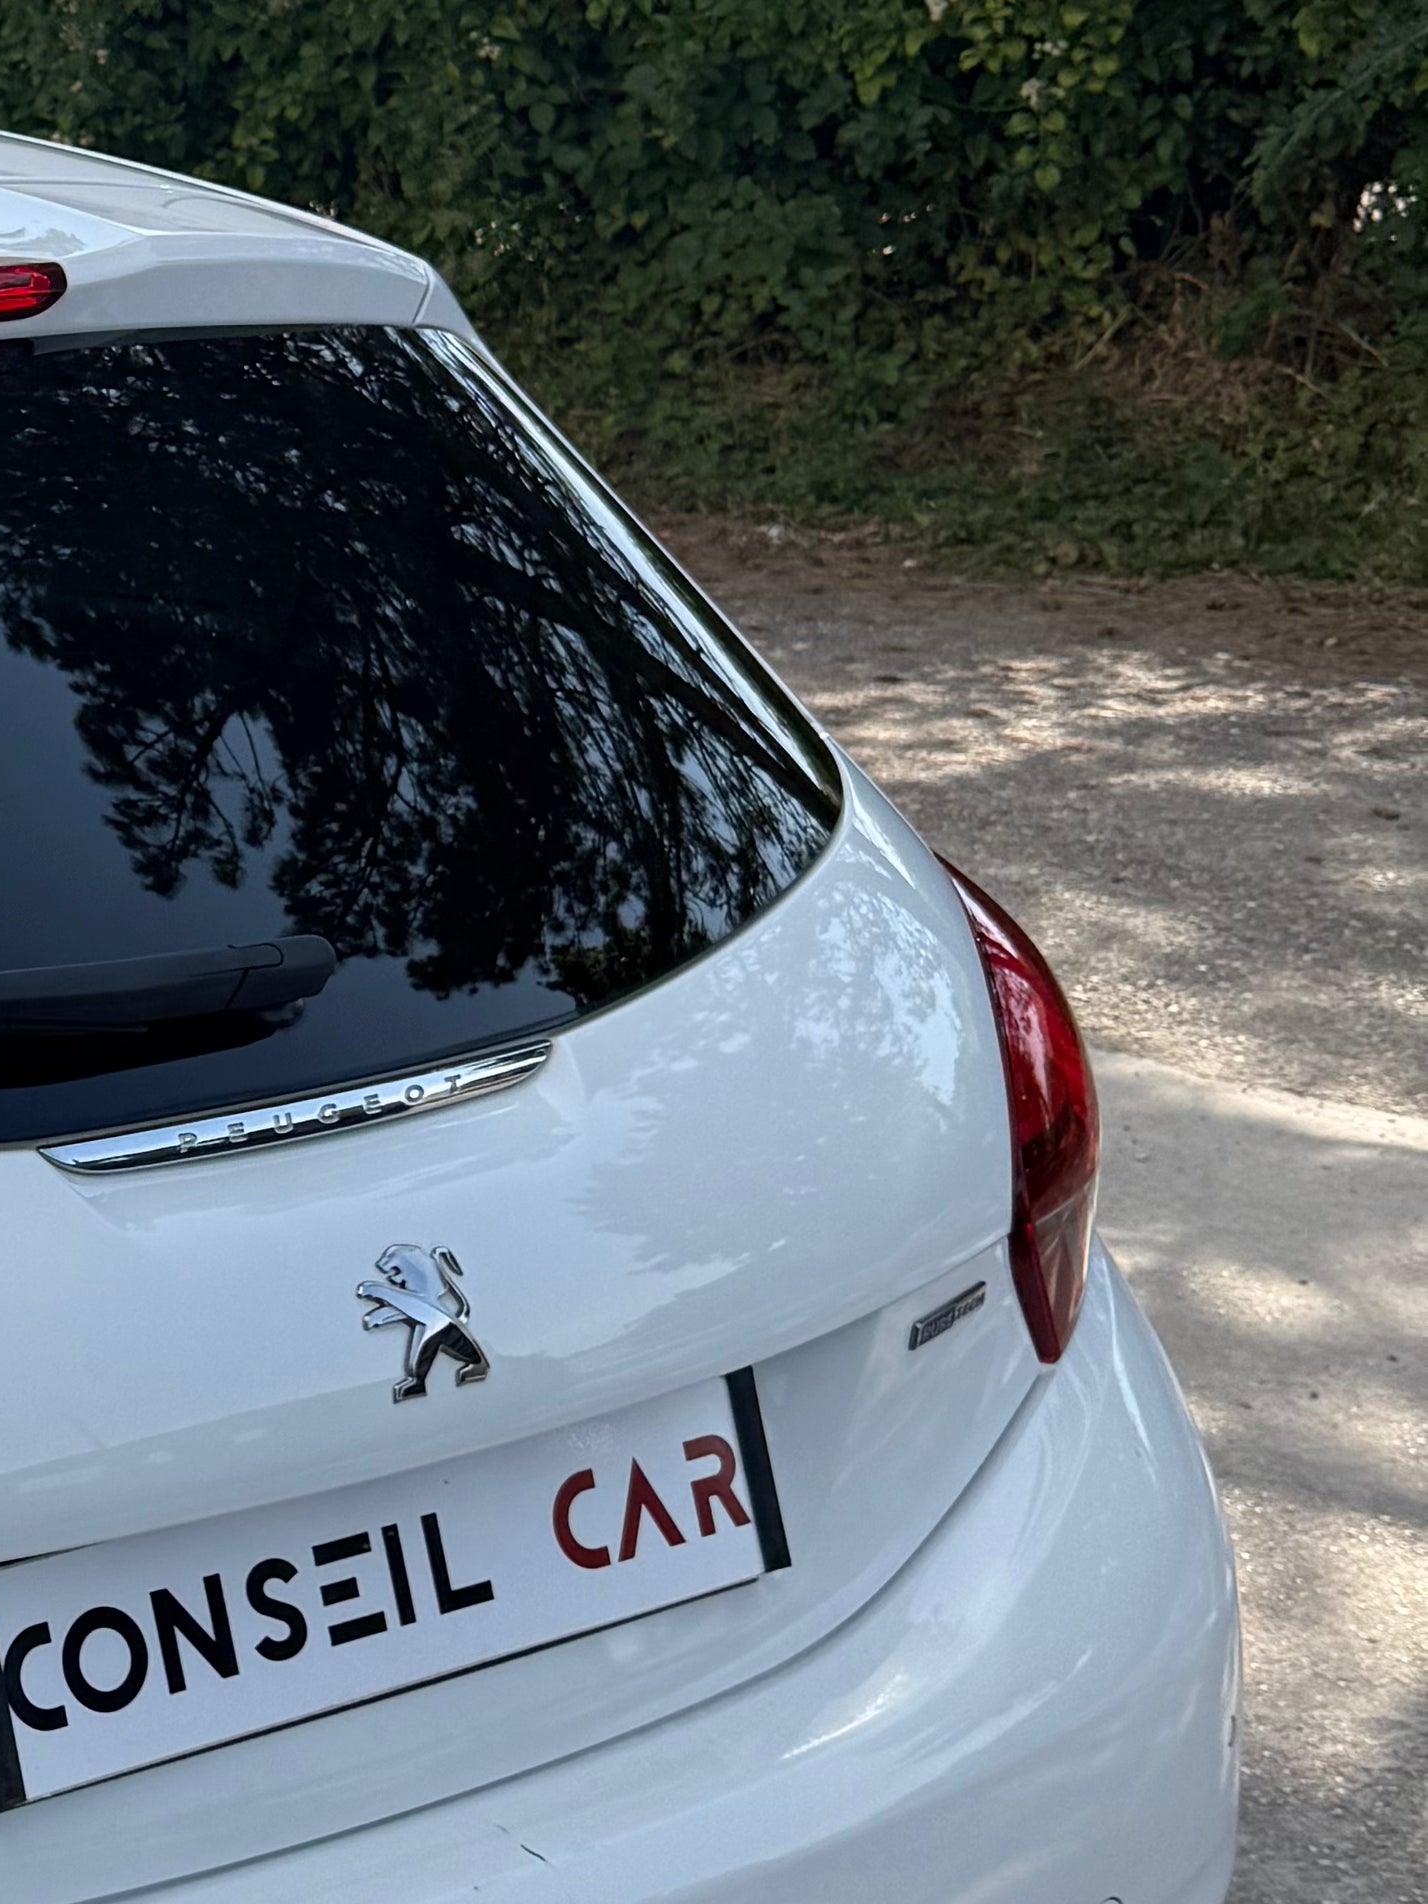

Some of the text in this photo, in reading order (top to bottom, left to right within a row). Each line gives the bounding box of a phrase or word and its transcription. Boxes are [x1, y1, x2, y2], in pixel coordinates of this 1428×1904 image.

[177, 1074, 462, 1154] PEUGEOT
[1, 1433, 752, 1732] CONSEIL CAR
